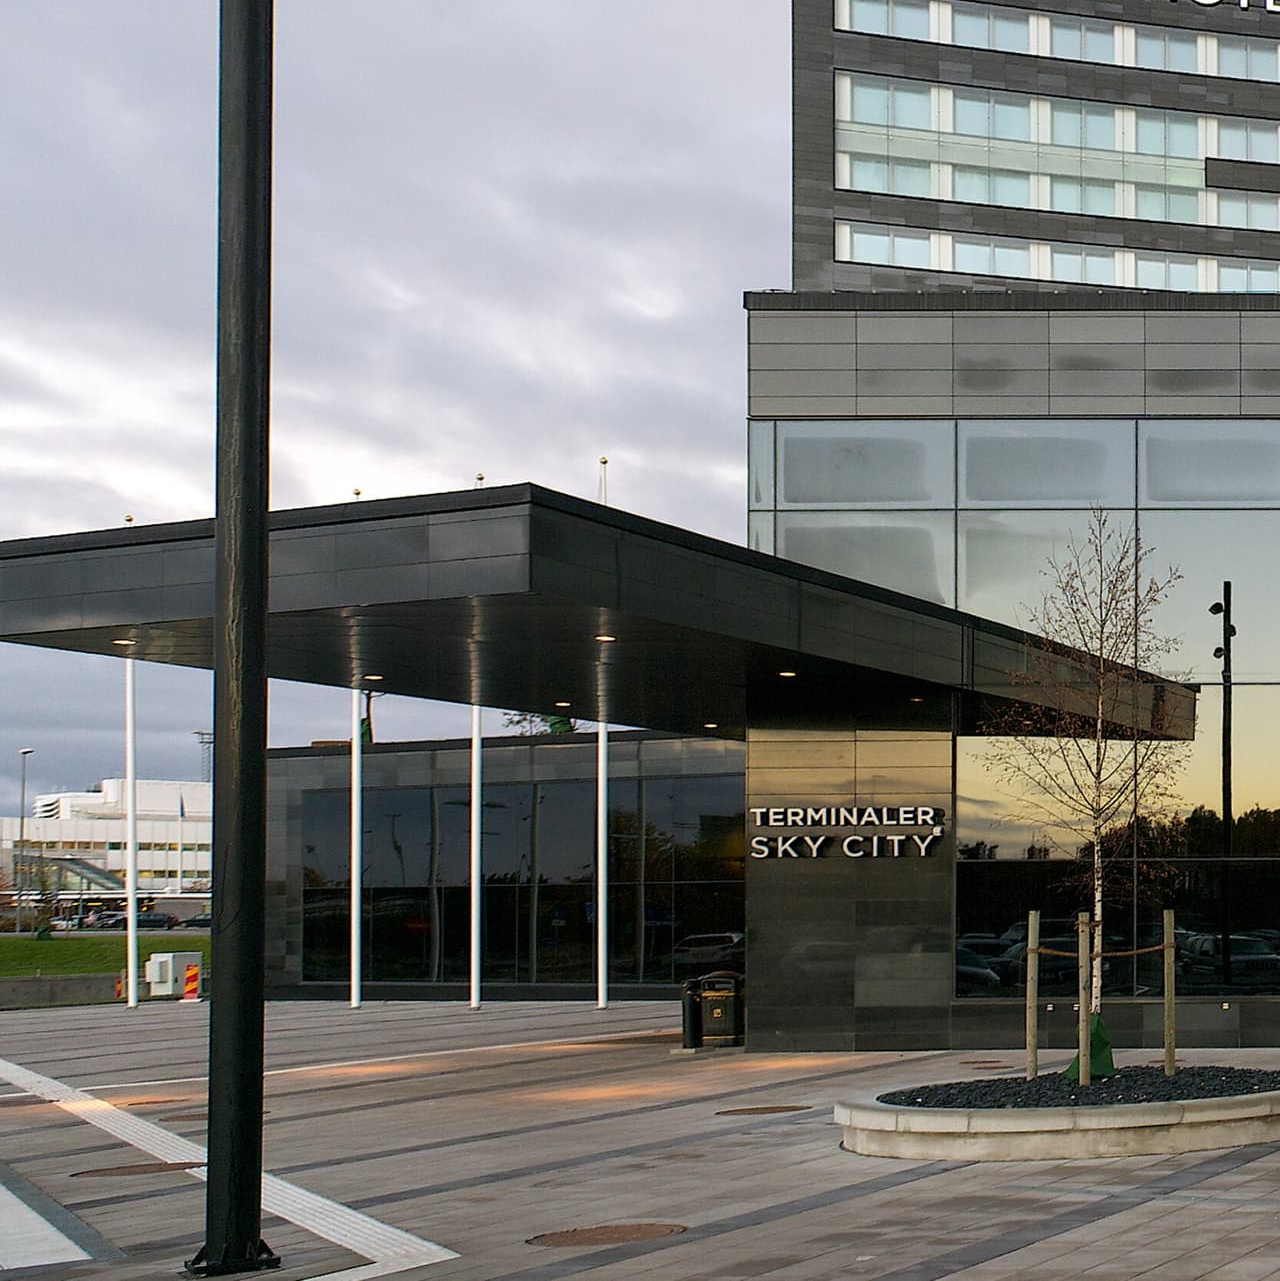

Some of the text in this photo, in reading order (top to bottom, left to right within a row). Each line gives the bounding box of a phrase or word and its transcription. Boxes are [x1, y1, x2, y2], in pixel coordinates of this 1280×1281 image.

[749, 805, 936, 827] TERMINALER
[750, 834, 935, 859] SKY CITY
